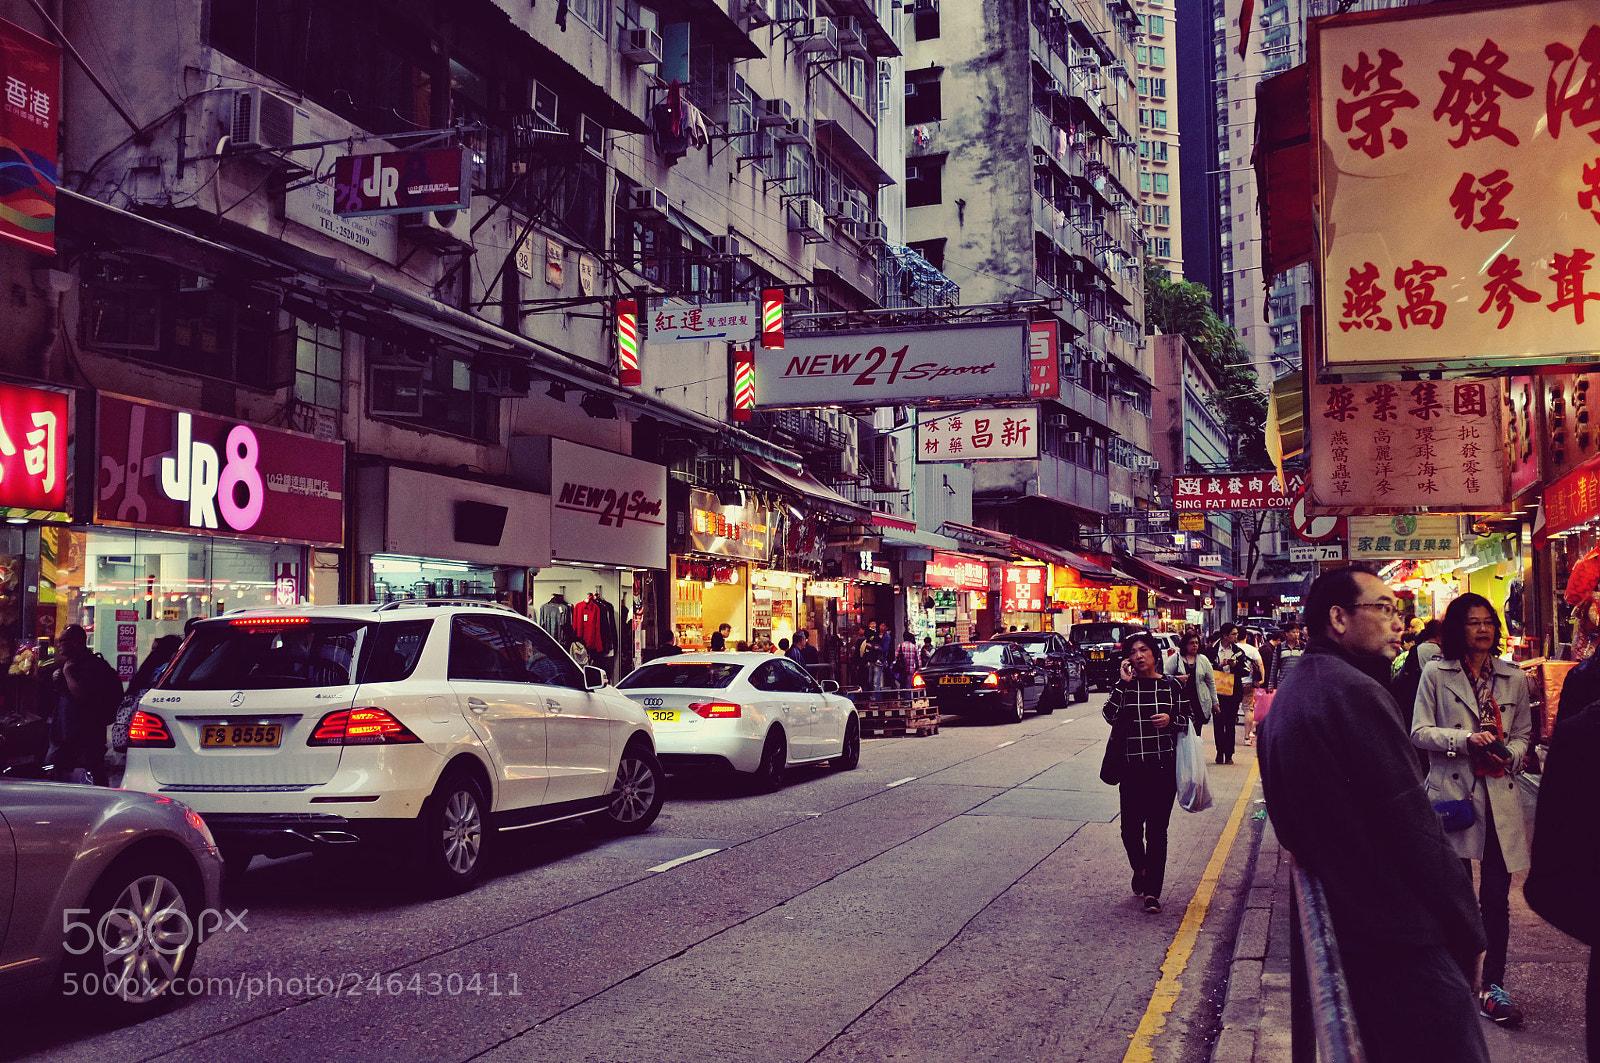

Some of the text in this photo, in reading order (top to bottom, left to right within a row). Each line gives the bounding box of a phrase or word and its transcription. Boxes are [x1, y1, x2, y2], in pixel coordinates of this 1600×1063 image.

[5, 76, 50, 119] 香港
[355, 233, 370, 247] 2199
[518, 252, 529, 270] 38
[654, 308, 705, 333] 紅運
[784, 353, 862, 376] NEW
[902, 362, 995, 381] Sport
[1323, 383, 1487, 422] 藥業集團
[1373, 427, 1396, 496] 高麗洋參
[1415, 426, 1440, 495] 環球海味
[1458, 425, 1483, 495] 批發零售
[558, 482, 606, 509] NEW
[627, 490, 663, 519] Sport
[1175, 499, 1202, 509] SING
[1206, 499, 1227, 508] FAT
[1231, 498, 1264, 508] MEAT
[1320, 548, 1339, 559] 7m
[120, 626, 134, 635] $60
[119, 665, 133, 675] $50
[652, 711, 674, 721] 302
[203, 727, 277, 745] FS 8555
